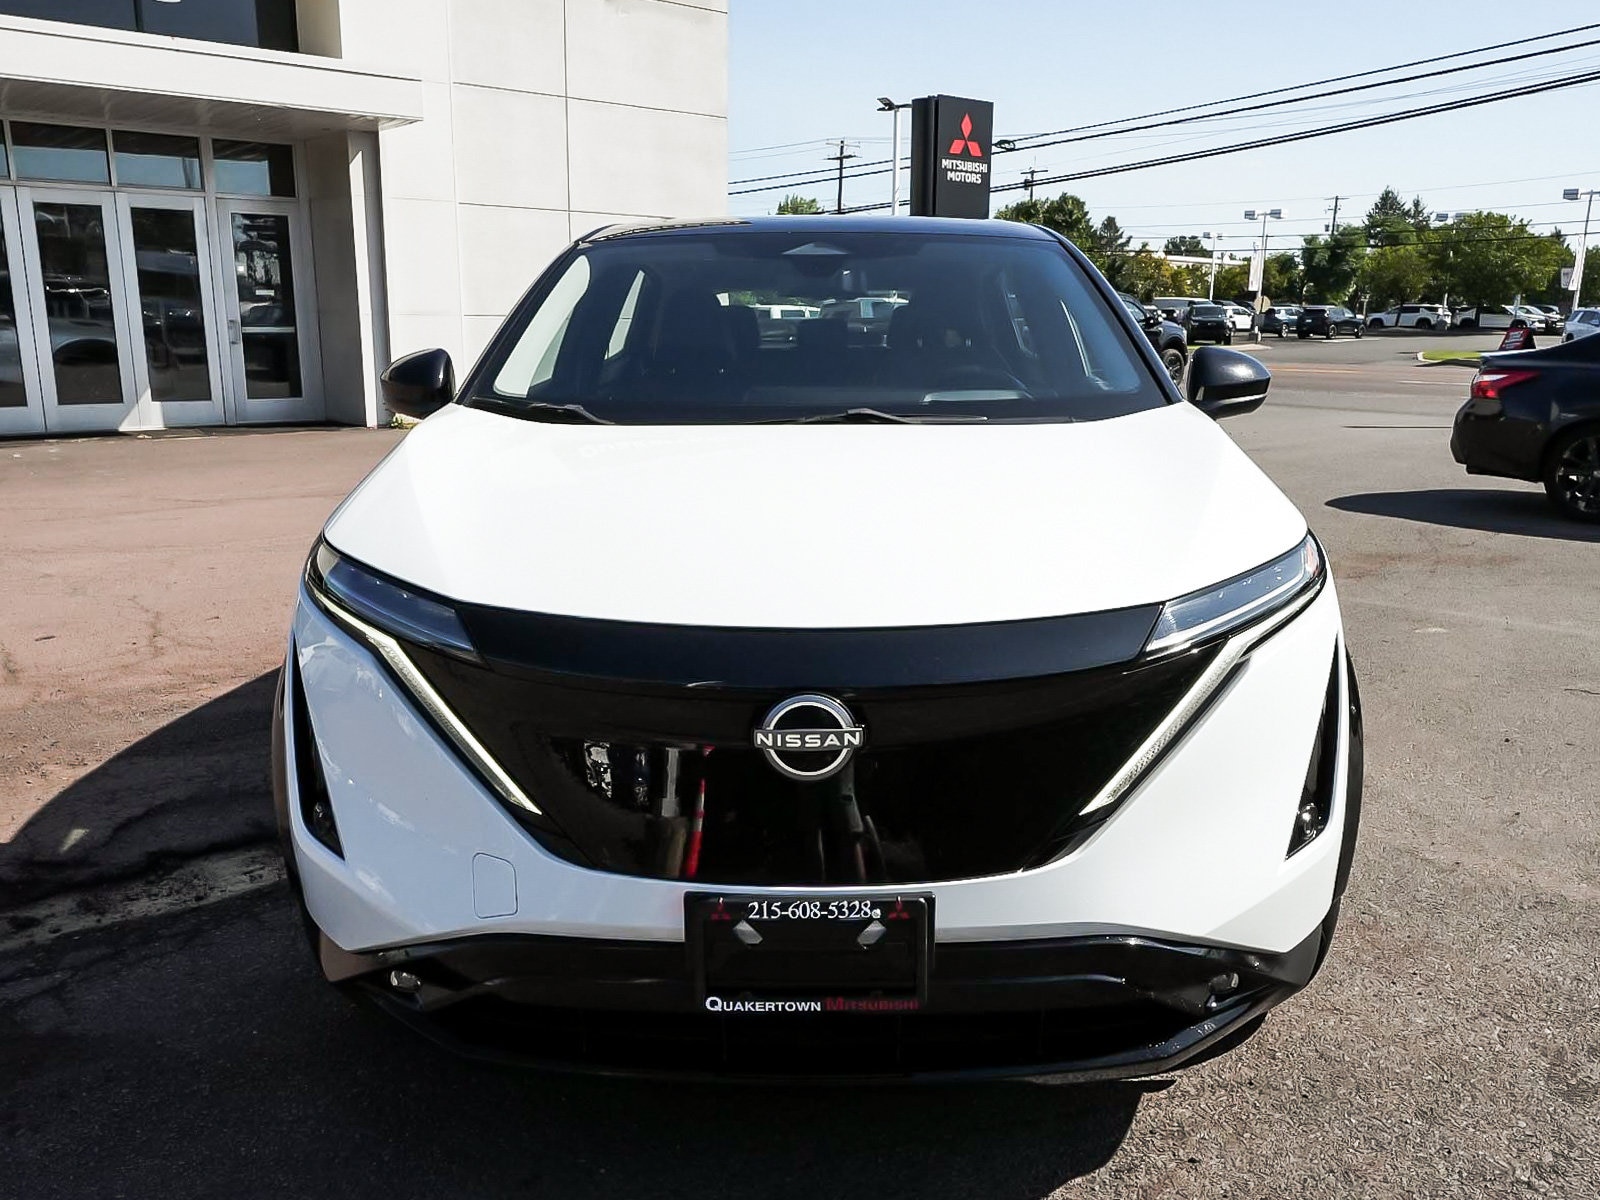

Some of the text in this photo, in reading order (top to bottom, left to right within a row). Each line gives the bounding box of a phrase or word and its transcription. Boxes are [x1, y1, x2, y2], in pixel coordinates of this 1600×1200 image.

[941, 159, 988, 173] MITSUBISHI
[947, 171, 982, 184] MOTORS
[756, 731, 860, 748] NISSAN
[748, 900, 871, 919] 215-608-5328
[705, 996, 919, 1012] QUAKERTOWN MITSUBISHI
